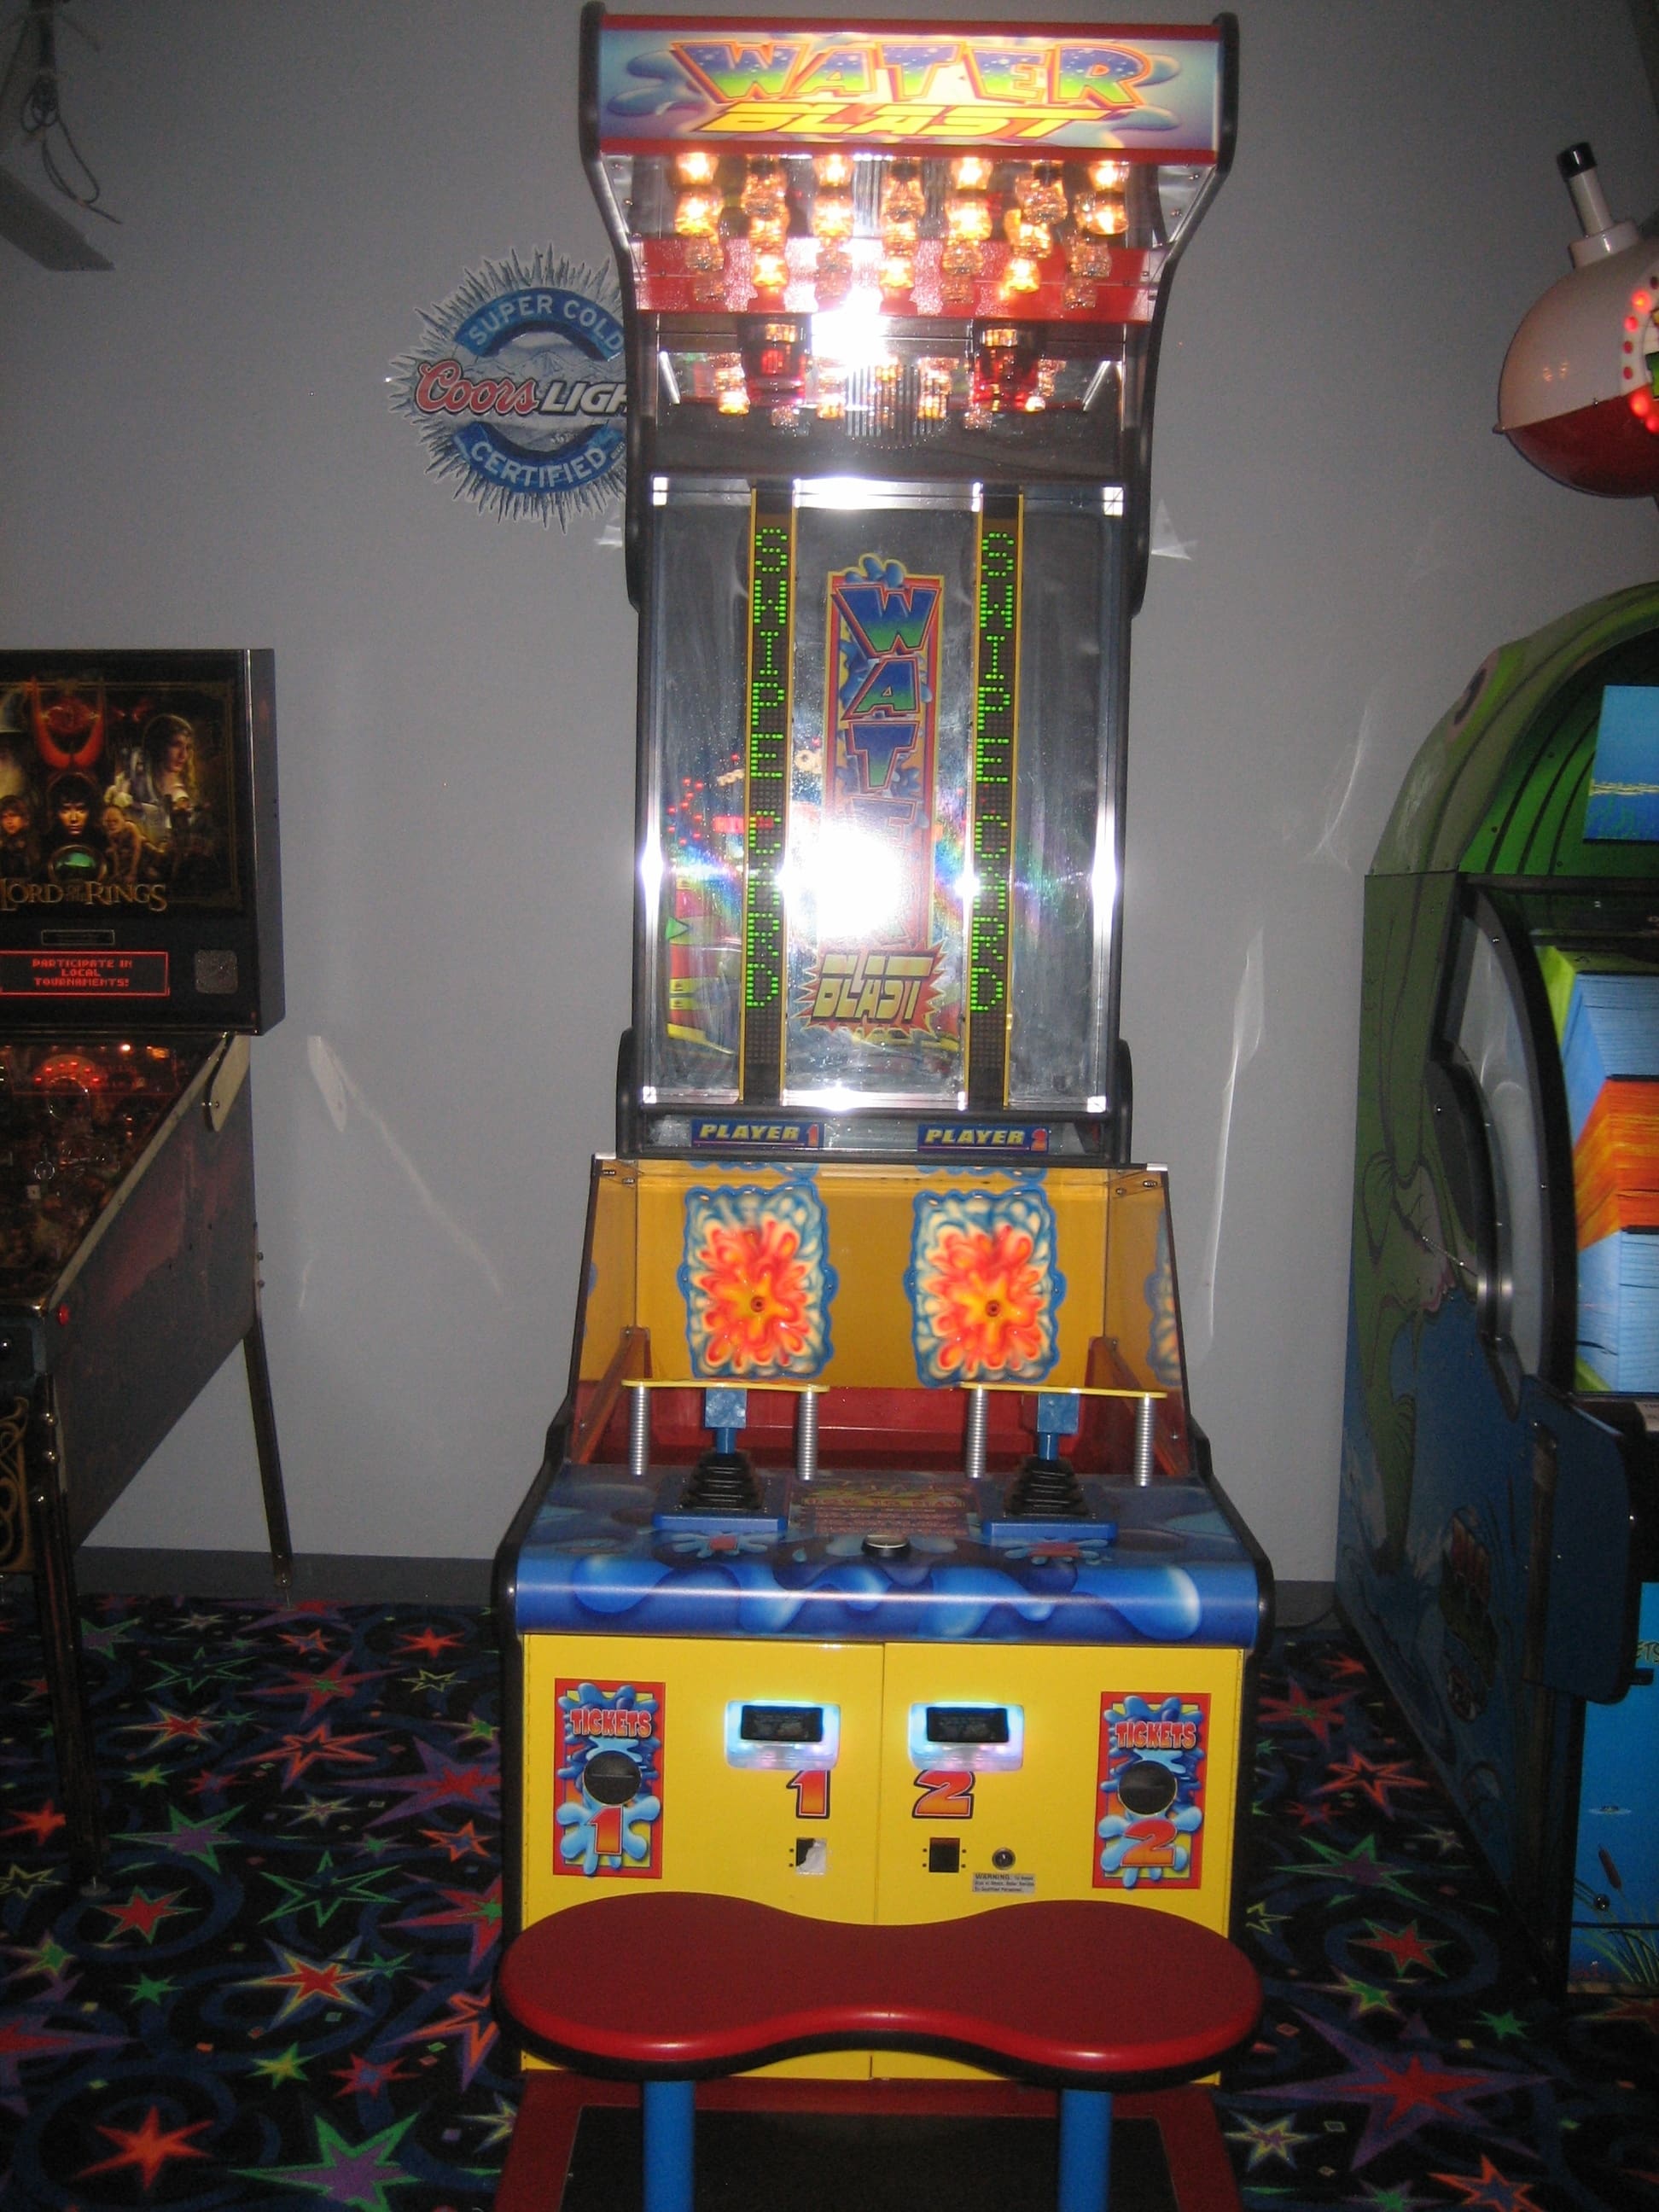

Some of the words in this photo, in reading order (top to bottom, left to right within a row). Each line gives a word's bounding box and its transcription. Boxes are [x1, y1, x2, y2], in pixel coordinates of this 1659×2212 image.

[672, 40, 1150, 108] WATER
[690, 102, 1114, 138] BLAST
[469, 294, 553, 346] SUPER
[563, 300, 624, 351] COLD
[416, 359, 540, 416] Coors
[471, 441, 607, 487] CERTIFIED
[750, 527, 788, 777] SWIPE
[975, 532, 1015, 783] SWIPE
[0, 877, 64, 911] LORD
[84, 881, 168, 911] RINGS
[746, 811, 782, 1007] CARD
[970, 814, 1009, 1011] CARD
[32, 958, 115, 968] PARTICIPATE
[119, 959, 133, 968] IN
[34, 977, 131, 987] TOURNAMENTS!
[61, 969, 102, 977] LOCAL
[812, 951, 936, 1022] BLAST
[699, 1123, 800, 1141] PLAYER
[806, 1123, 820, 1148] 1
[924, 1128, 1025, 1146] PLAYER
[1030, 1128, 1048, 1152] 2
[569, 1708, 653, 1738] TICKETS
[1115, 1720, 1197, 1749] TICKETS
[786, 1769, 831, 1819] 1
[912, 1769, 975, 1819] 2
[585, 1804, 624, 1855] 1
[1120, 1818, 1178, 1868] 2
